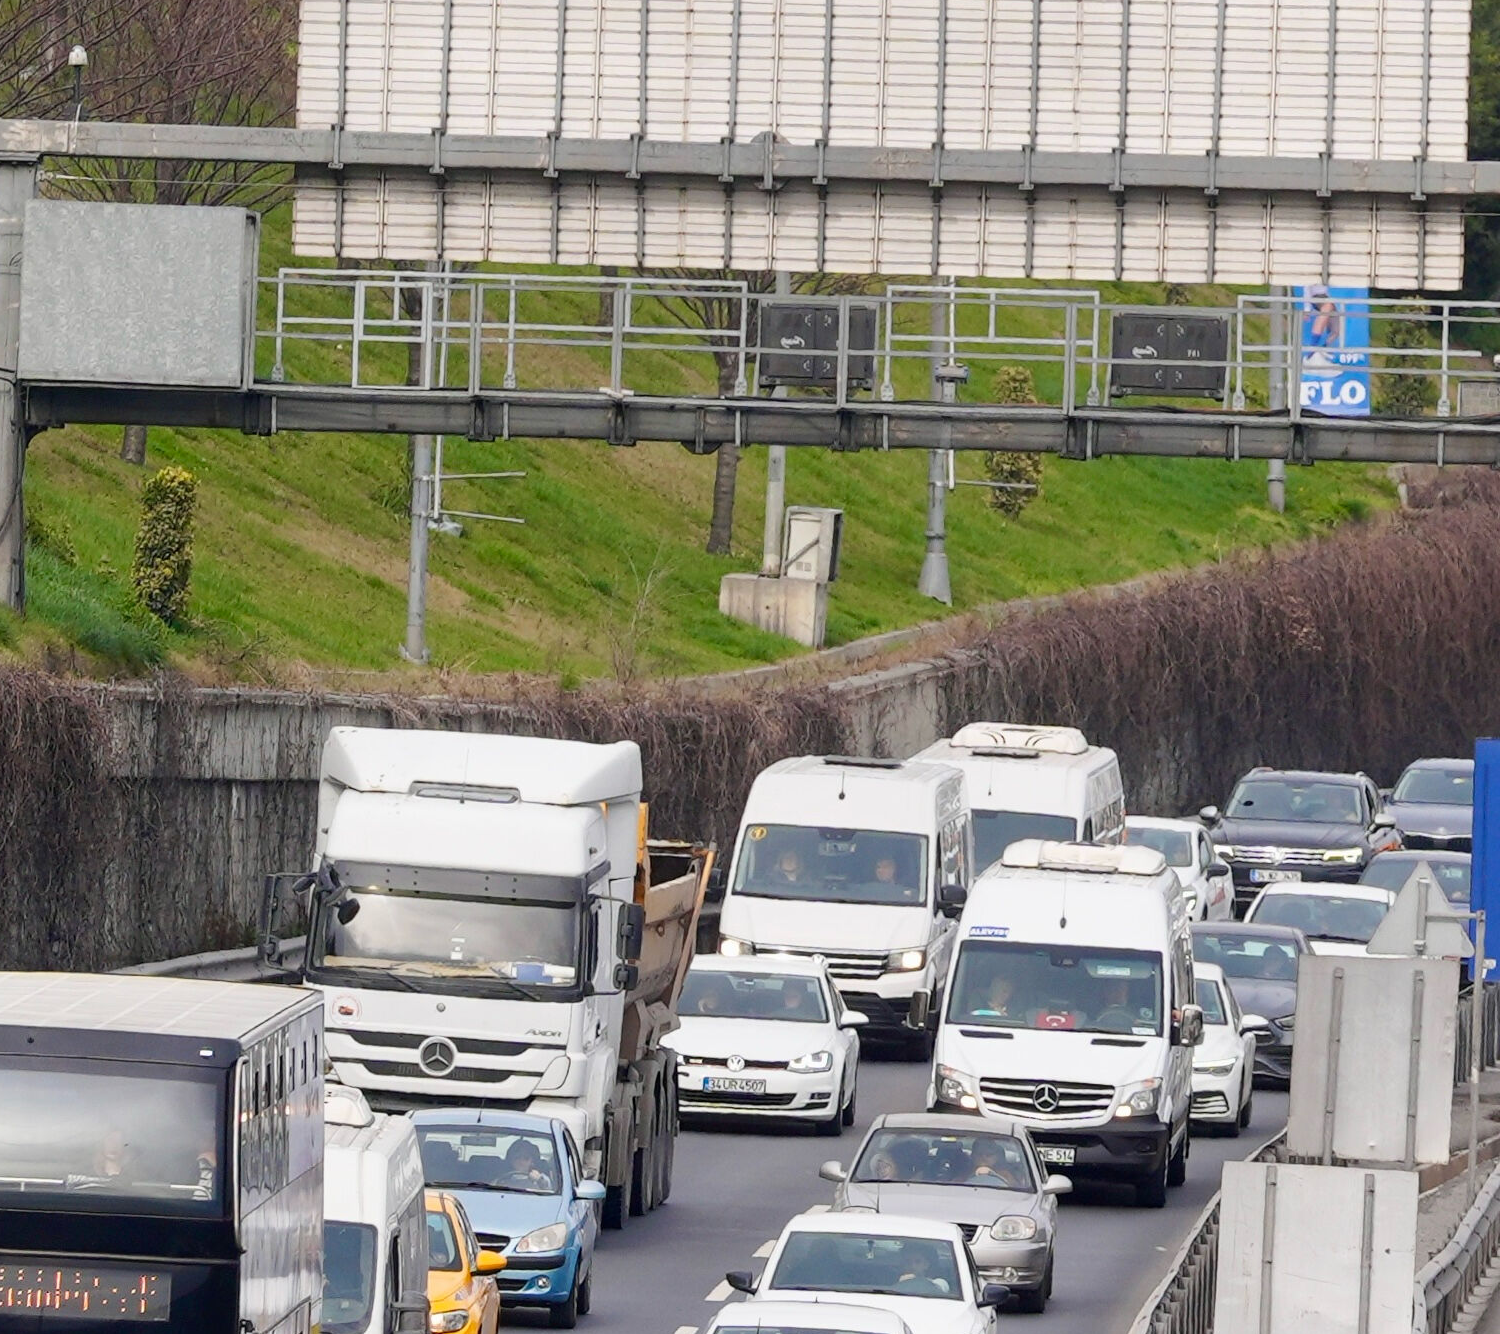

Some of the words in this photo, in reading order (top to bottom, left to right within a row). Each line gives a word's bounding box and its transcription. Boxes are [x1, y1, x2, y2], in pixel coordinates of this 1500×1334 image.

[1299, 379, 1367, 406] FLO
[710, 1079, 722, 1090] 34
[739, 1080, 765, 1092] 4507
[1056, 1149, 1073, 1162] 514
